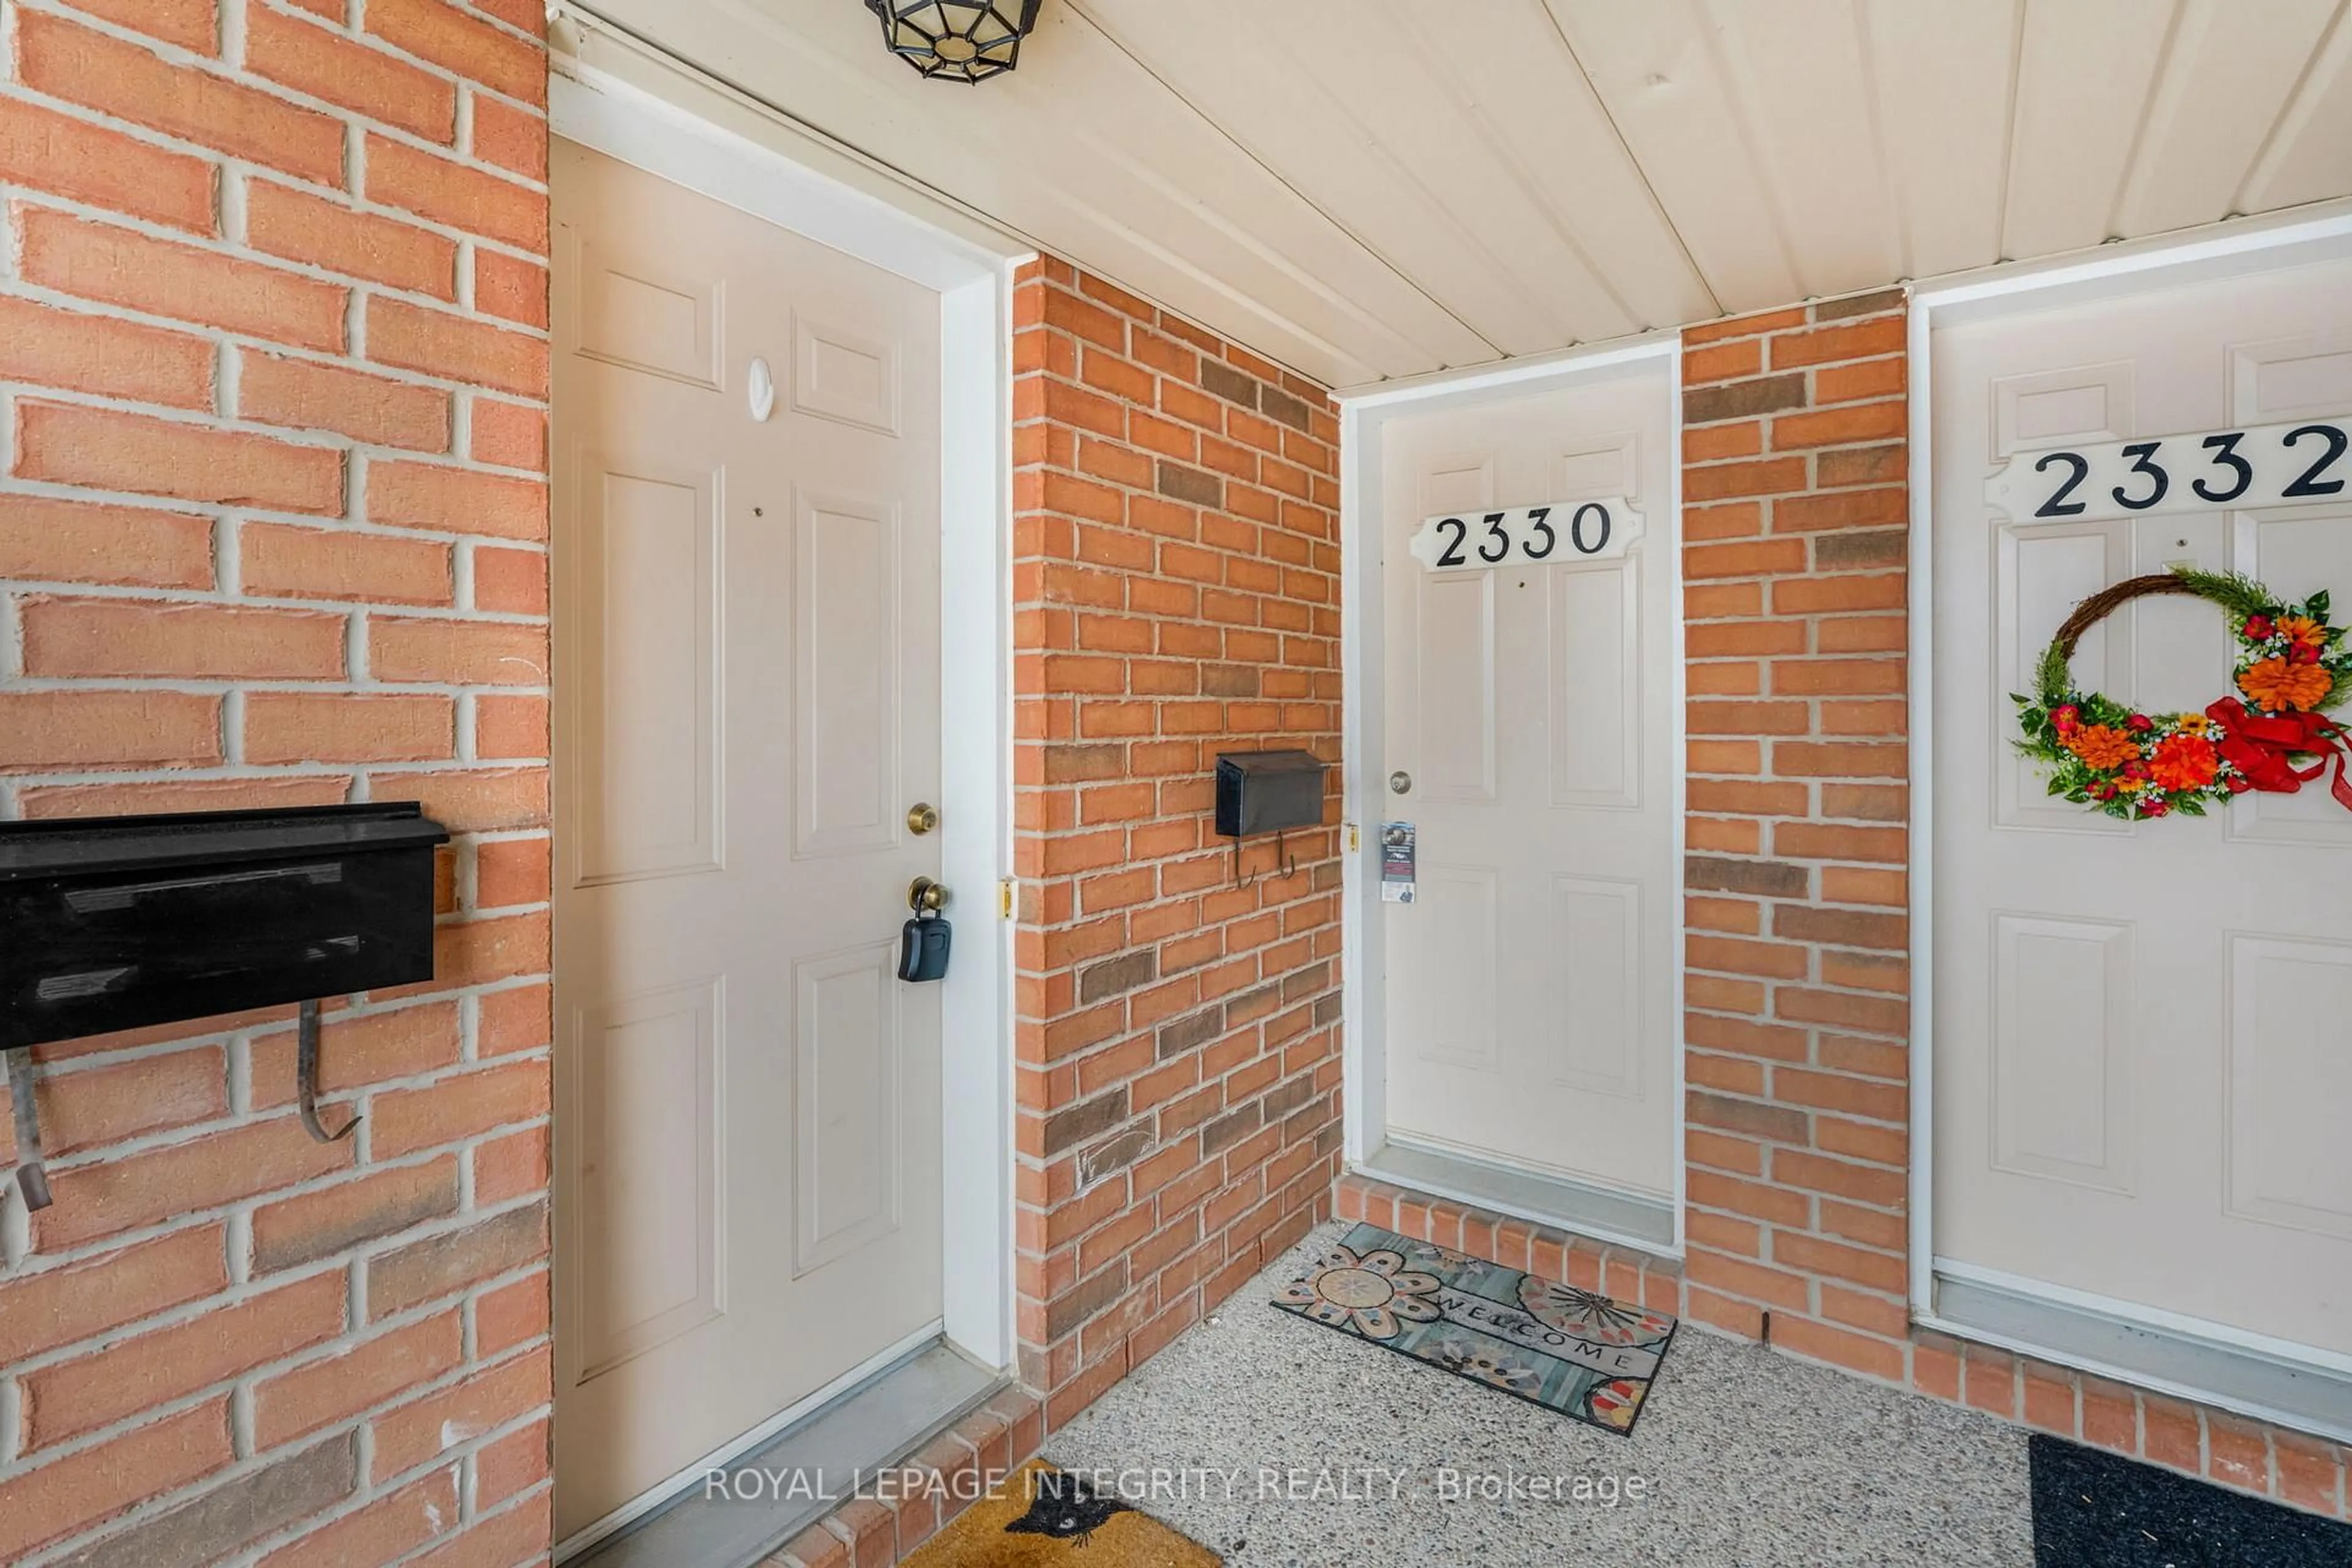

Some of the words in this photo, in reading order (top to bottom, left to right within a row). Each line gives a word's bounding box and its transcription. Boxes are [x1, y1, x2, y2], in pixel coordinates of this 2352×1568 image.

[2034, 425, 2348, 517] 2332
[1436, 503, 1611, 567] 2330
[1437, 1295, 1635, 1370] WELCOME
